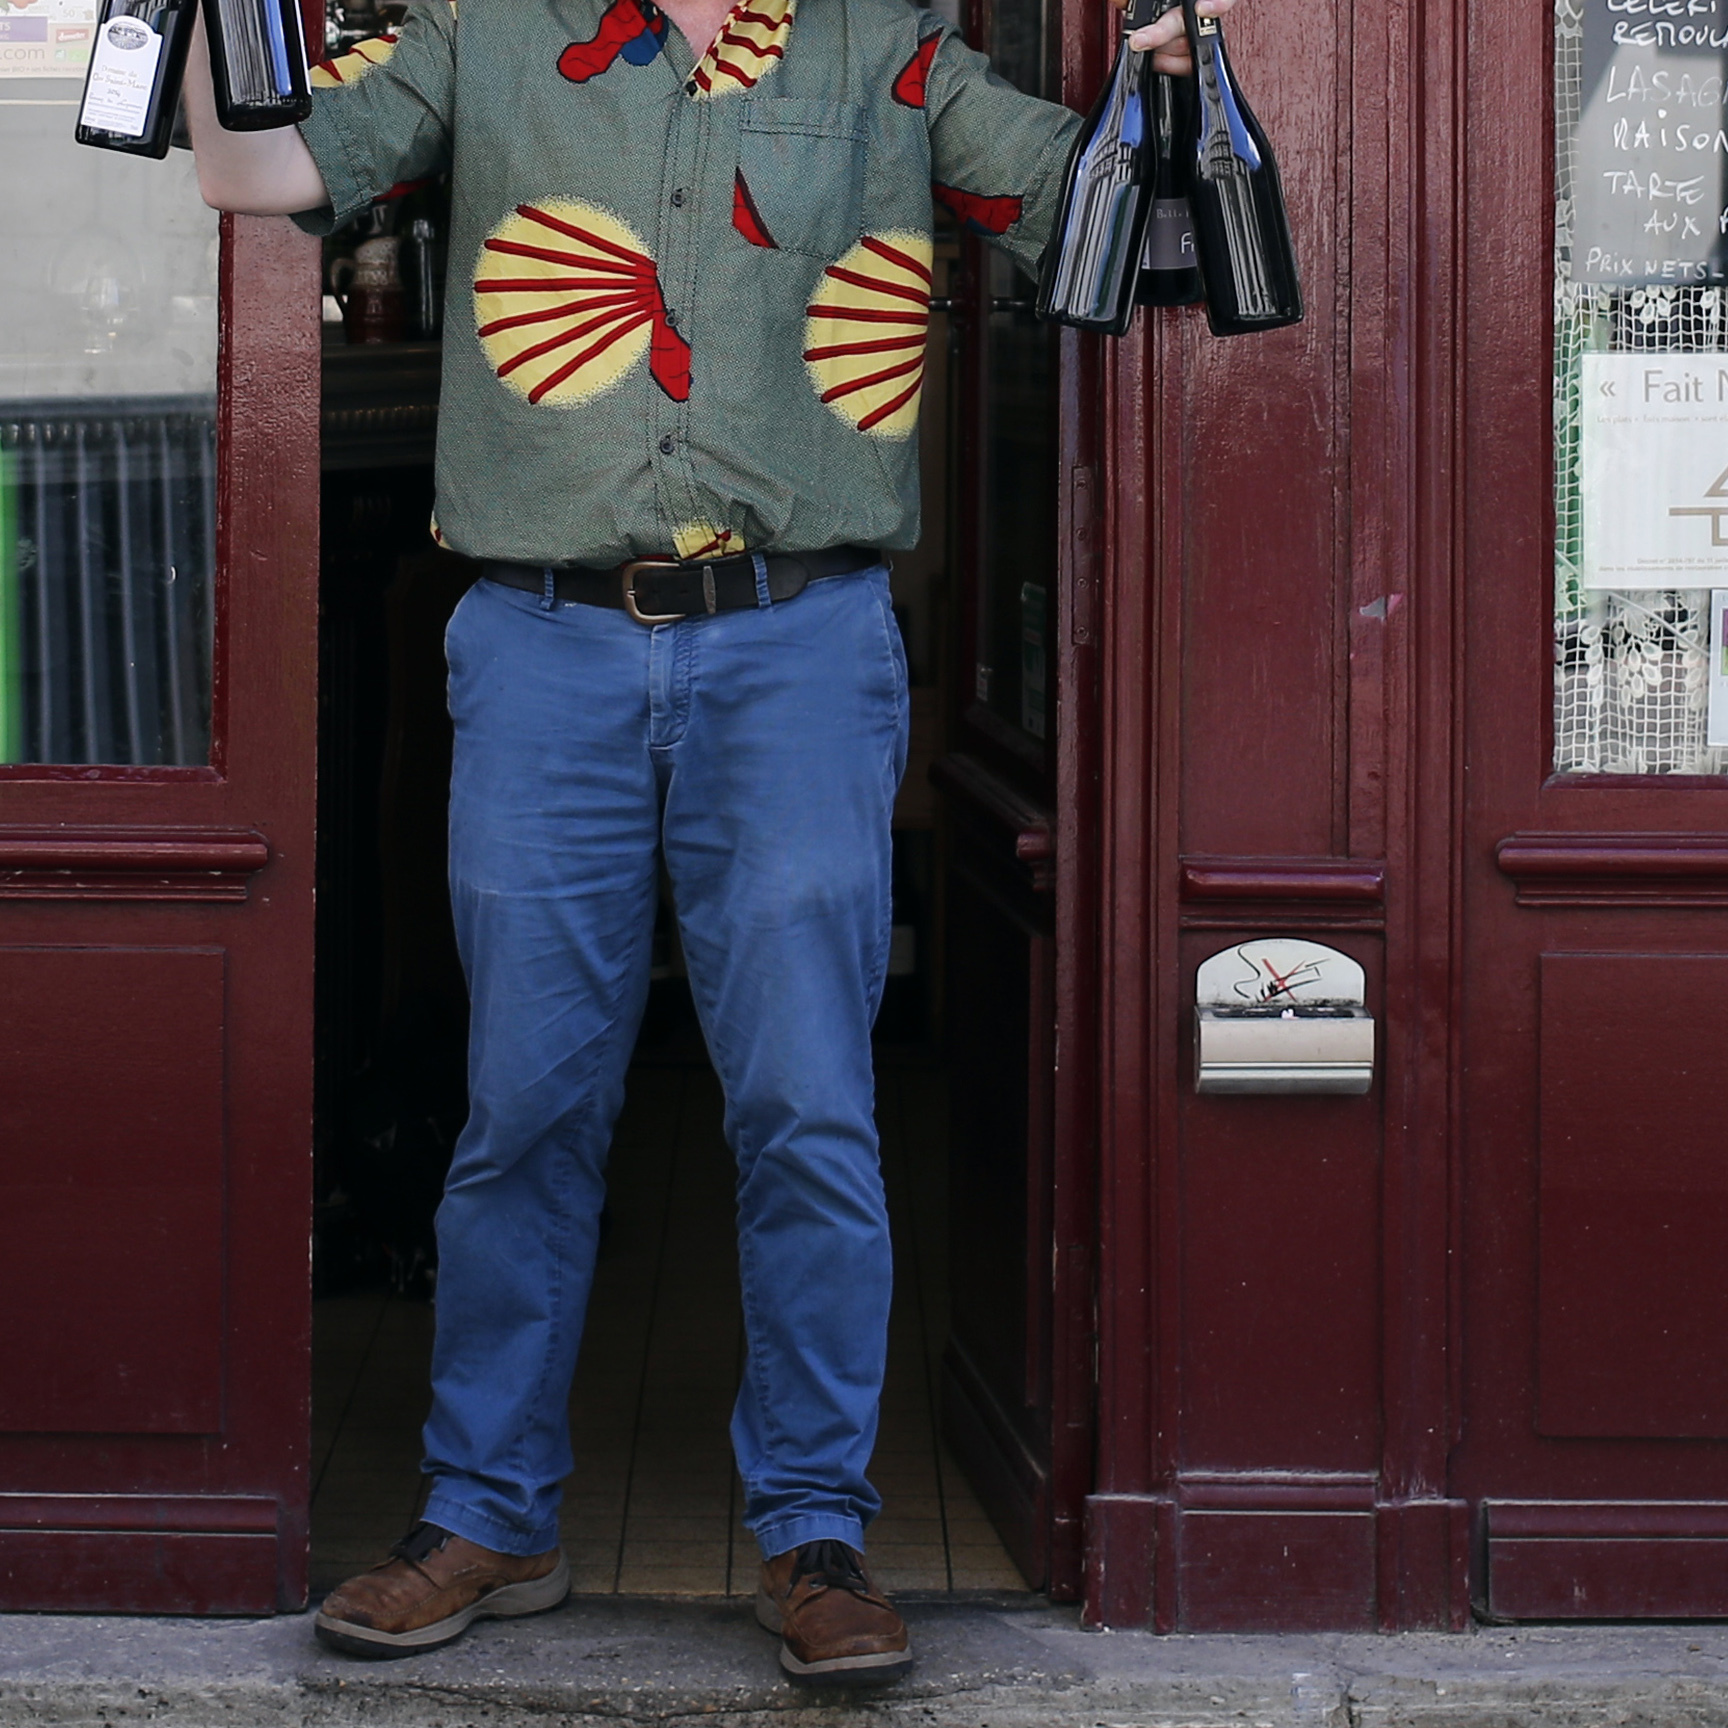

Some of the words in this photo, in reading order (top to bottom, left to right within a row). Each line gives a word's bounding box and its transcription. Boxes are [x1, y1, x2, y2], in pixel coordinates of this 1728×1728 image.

[1602, 170, 1706, 205] TARTE
[1643, 210, 1703, 240] AUX
[1585, 247, 1635, 275] PRIX
[1642, 368, 1705, 405] Fait
